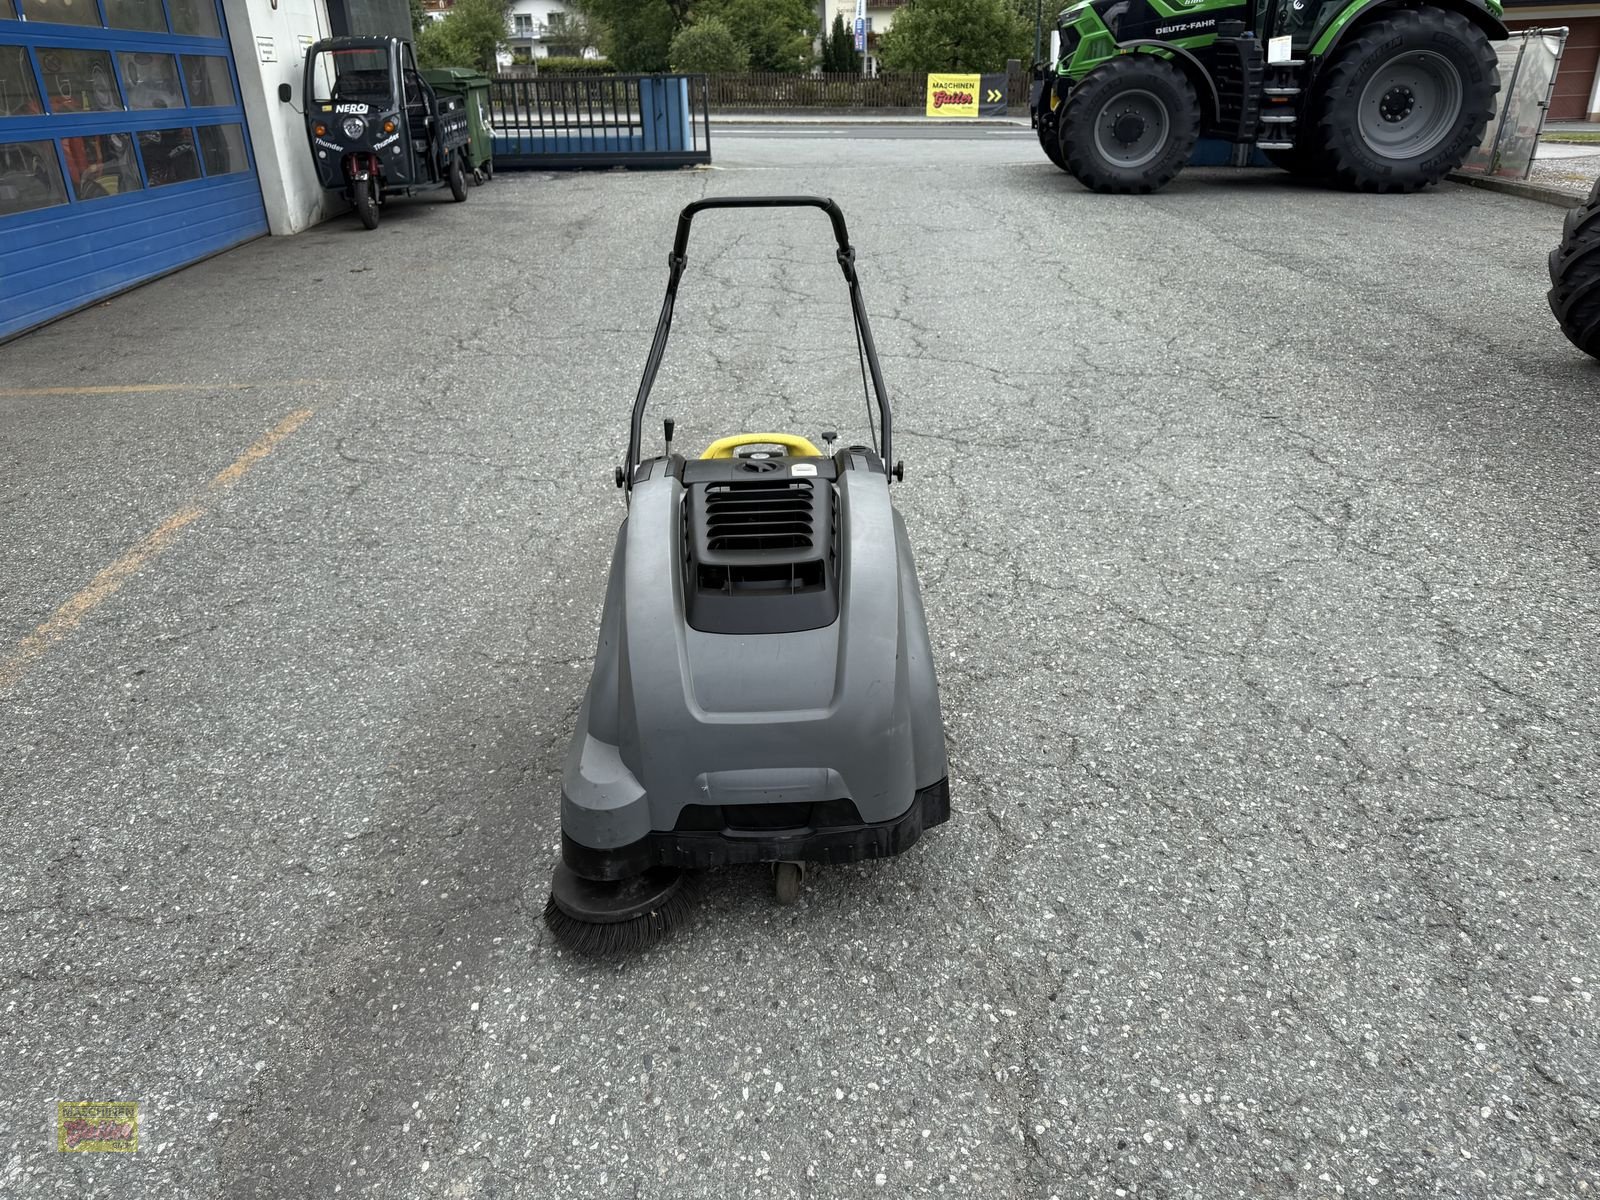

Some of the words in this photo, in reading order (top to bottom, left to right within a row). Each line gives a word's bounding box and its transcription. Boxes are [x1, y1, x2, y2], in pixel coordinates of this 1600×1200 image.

[1155, 19, 1216, 35] DEUTZ-FAHR
[335, 103, 369, 114] NERO
[315, 138, 344, 152] Thunder
[373, 132, 400, 151] Thunder
